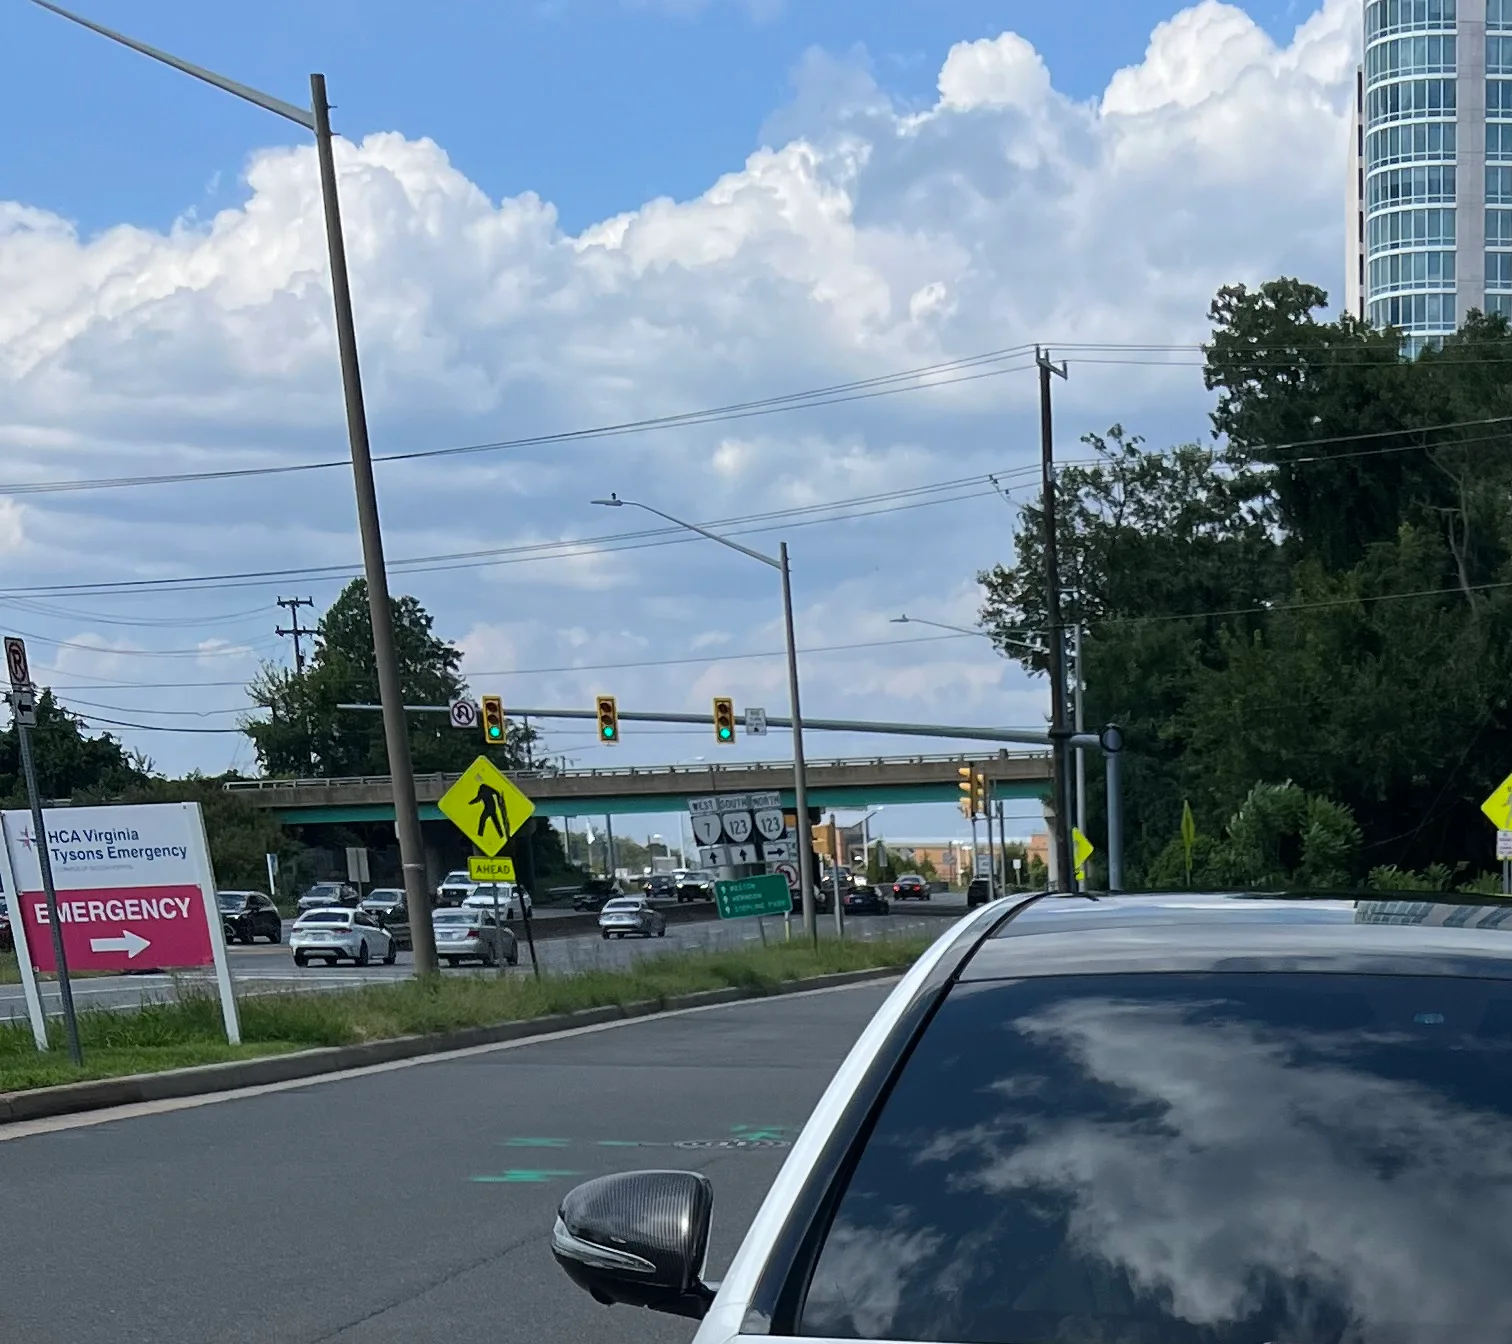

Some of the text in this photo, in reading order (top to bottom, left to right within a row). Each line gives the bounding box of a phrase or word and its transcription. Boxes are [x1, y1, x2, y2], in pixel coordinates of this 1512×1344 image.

[692, 800, 714, 811] WEST
[720, 798, 747, 810] SOUTH
[704, 823, 711, 838] 7
[729, 819, 748, 836] 123
[761, 816, 780, 832] 123
[48, 827, 139, 845] HCA Virginia
[51, 846, 188, 864] Tysons Emergency
[476, 864, 511, 875] AHEAD
[34, 897, 191, 925] EMERGENCY
